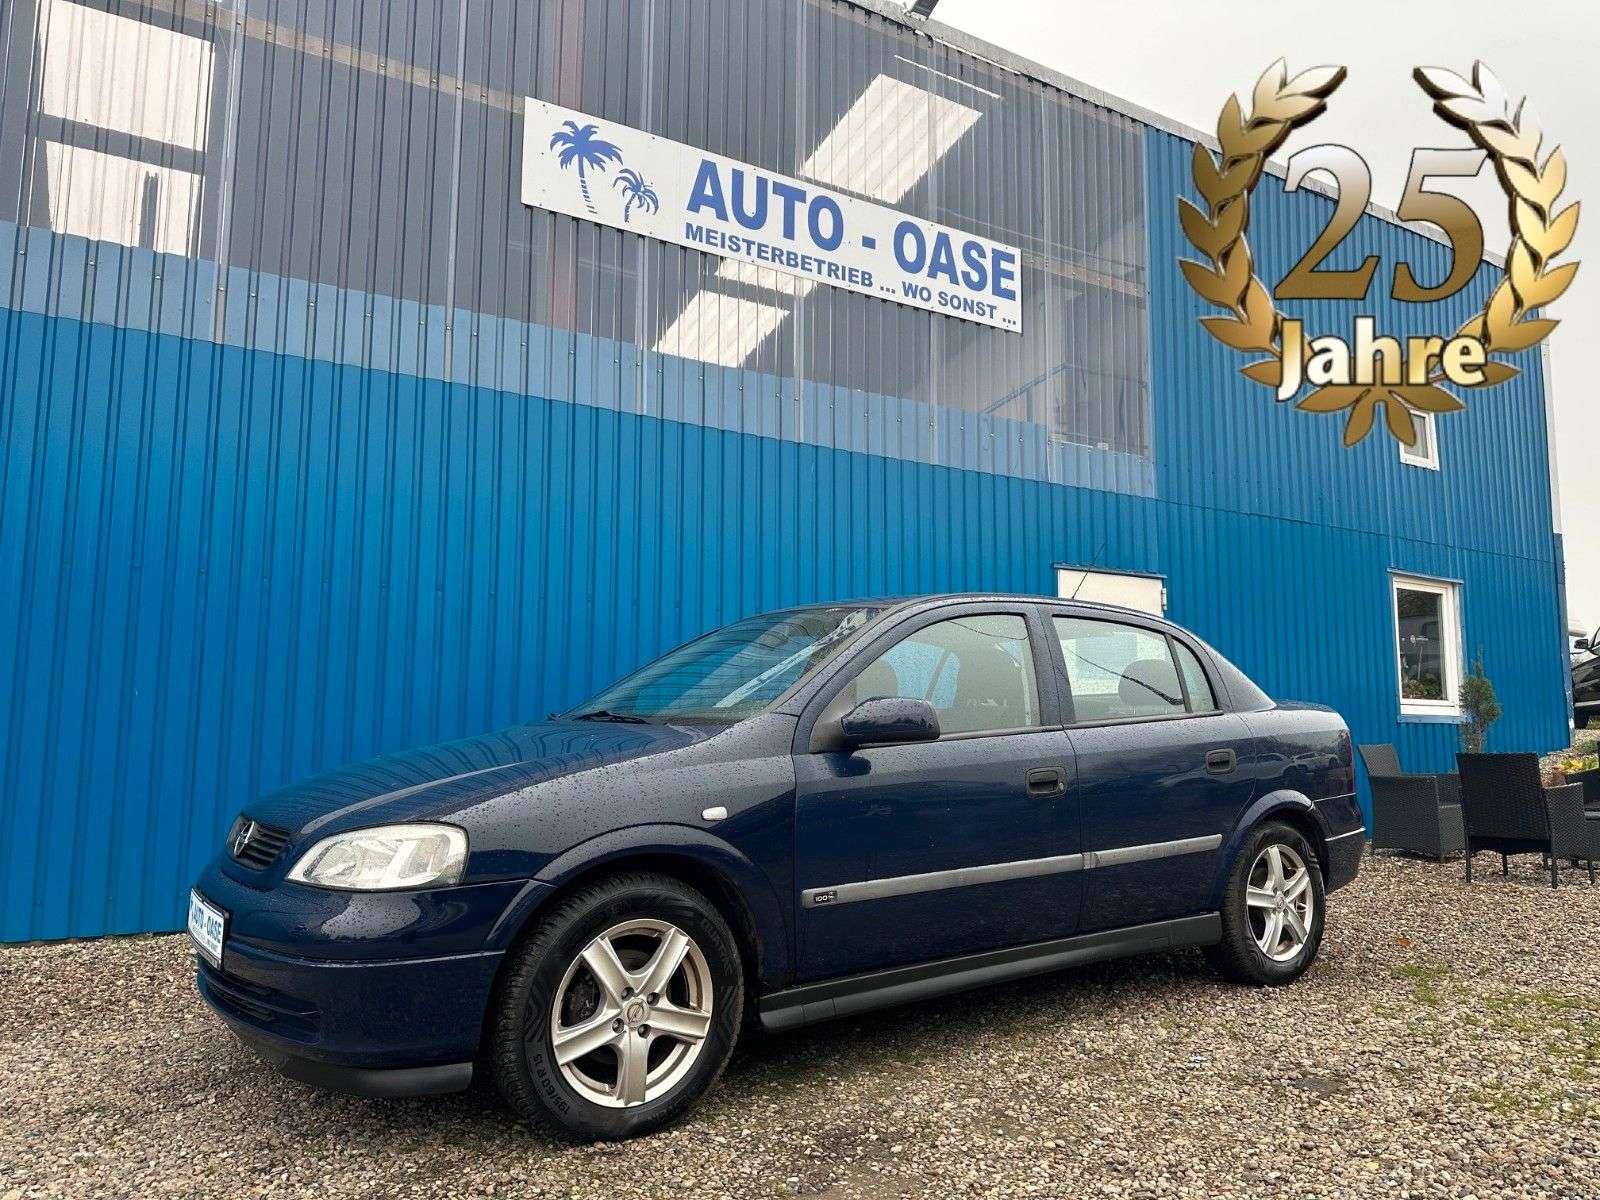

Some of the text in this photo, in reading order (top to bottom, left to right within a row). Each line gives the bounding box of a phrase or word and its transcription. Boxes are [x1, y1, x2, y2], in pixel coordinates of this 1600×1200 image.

[687, 159, 1016, 302] AUTO - OASE
[685, 222, 873, 288] MEISTERBETRIEB
[902, 281, 932, 303] WO
[938, 291, 998, 320] SONST
[207, 916, 222, 944] OASE
[541, 1078, 571, 1115] 195/60
